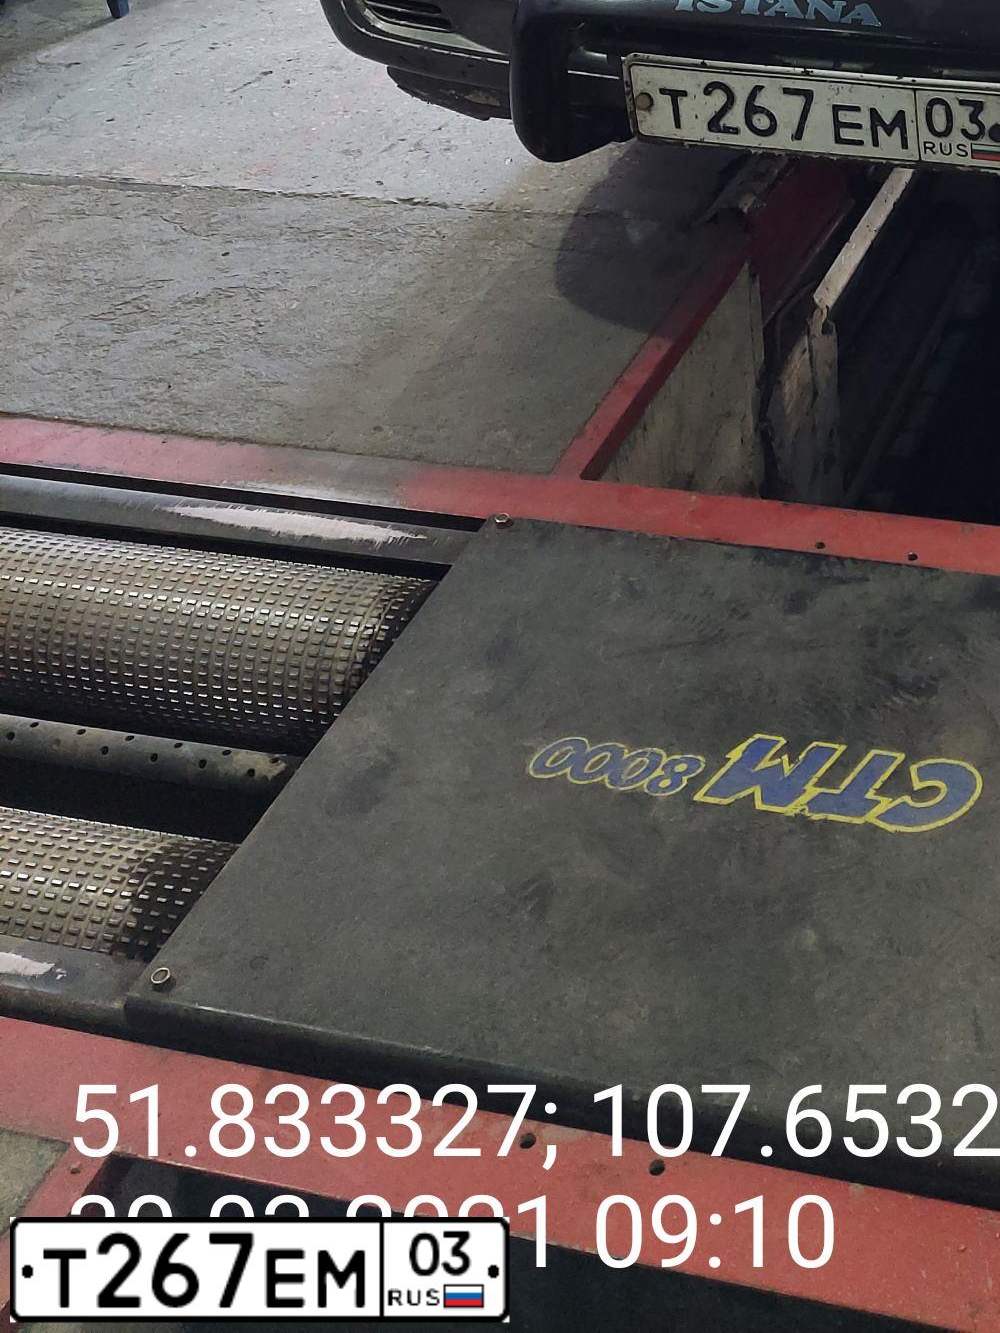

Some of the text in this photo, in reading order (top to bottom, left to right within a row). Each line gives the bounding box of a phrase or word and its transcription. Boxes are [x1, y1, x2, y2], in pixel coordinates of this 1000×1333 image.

[925, 97, 987, 141] 03
[923, 140, 969, 158] RUS
[529, 737, 705, 797] 8000
